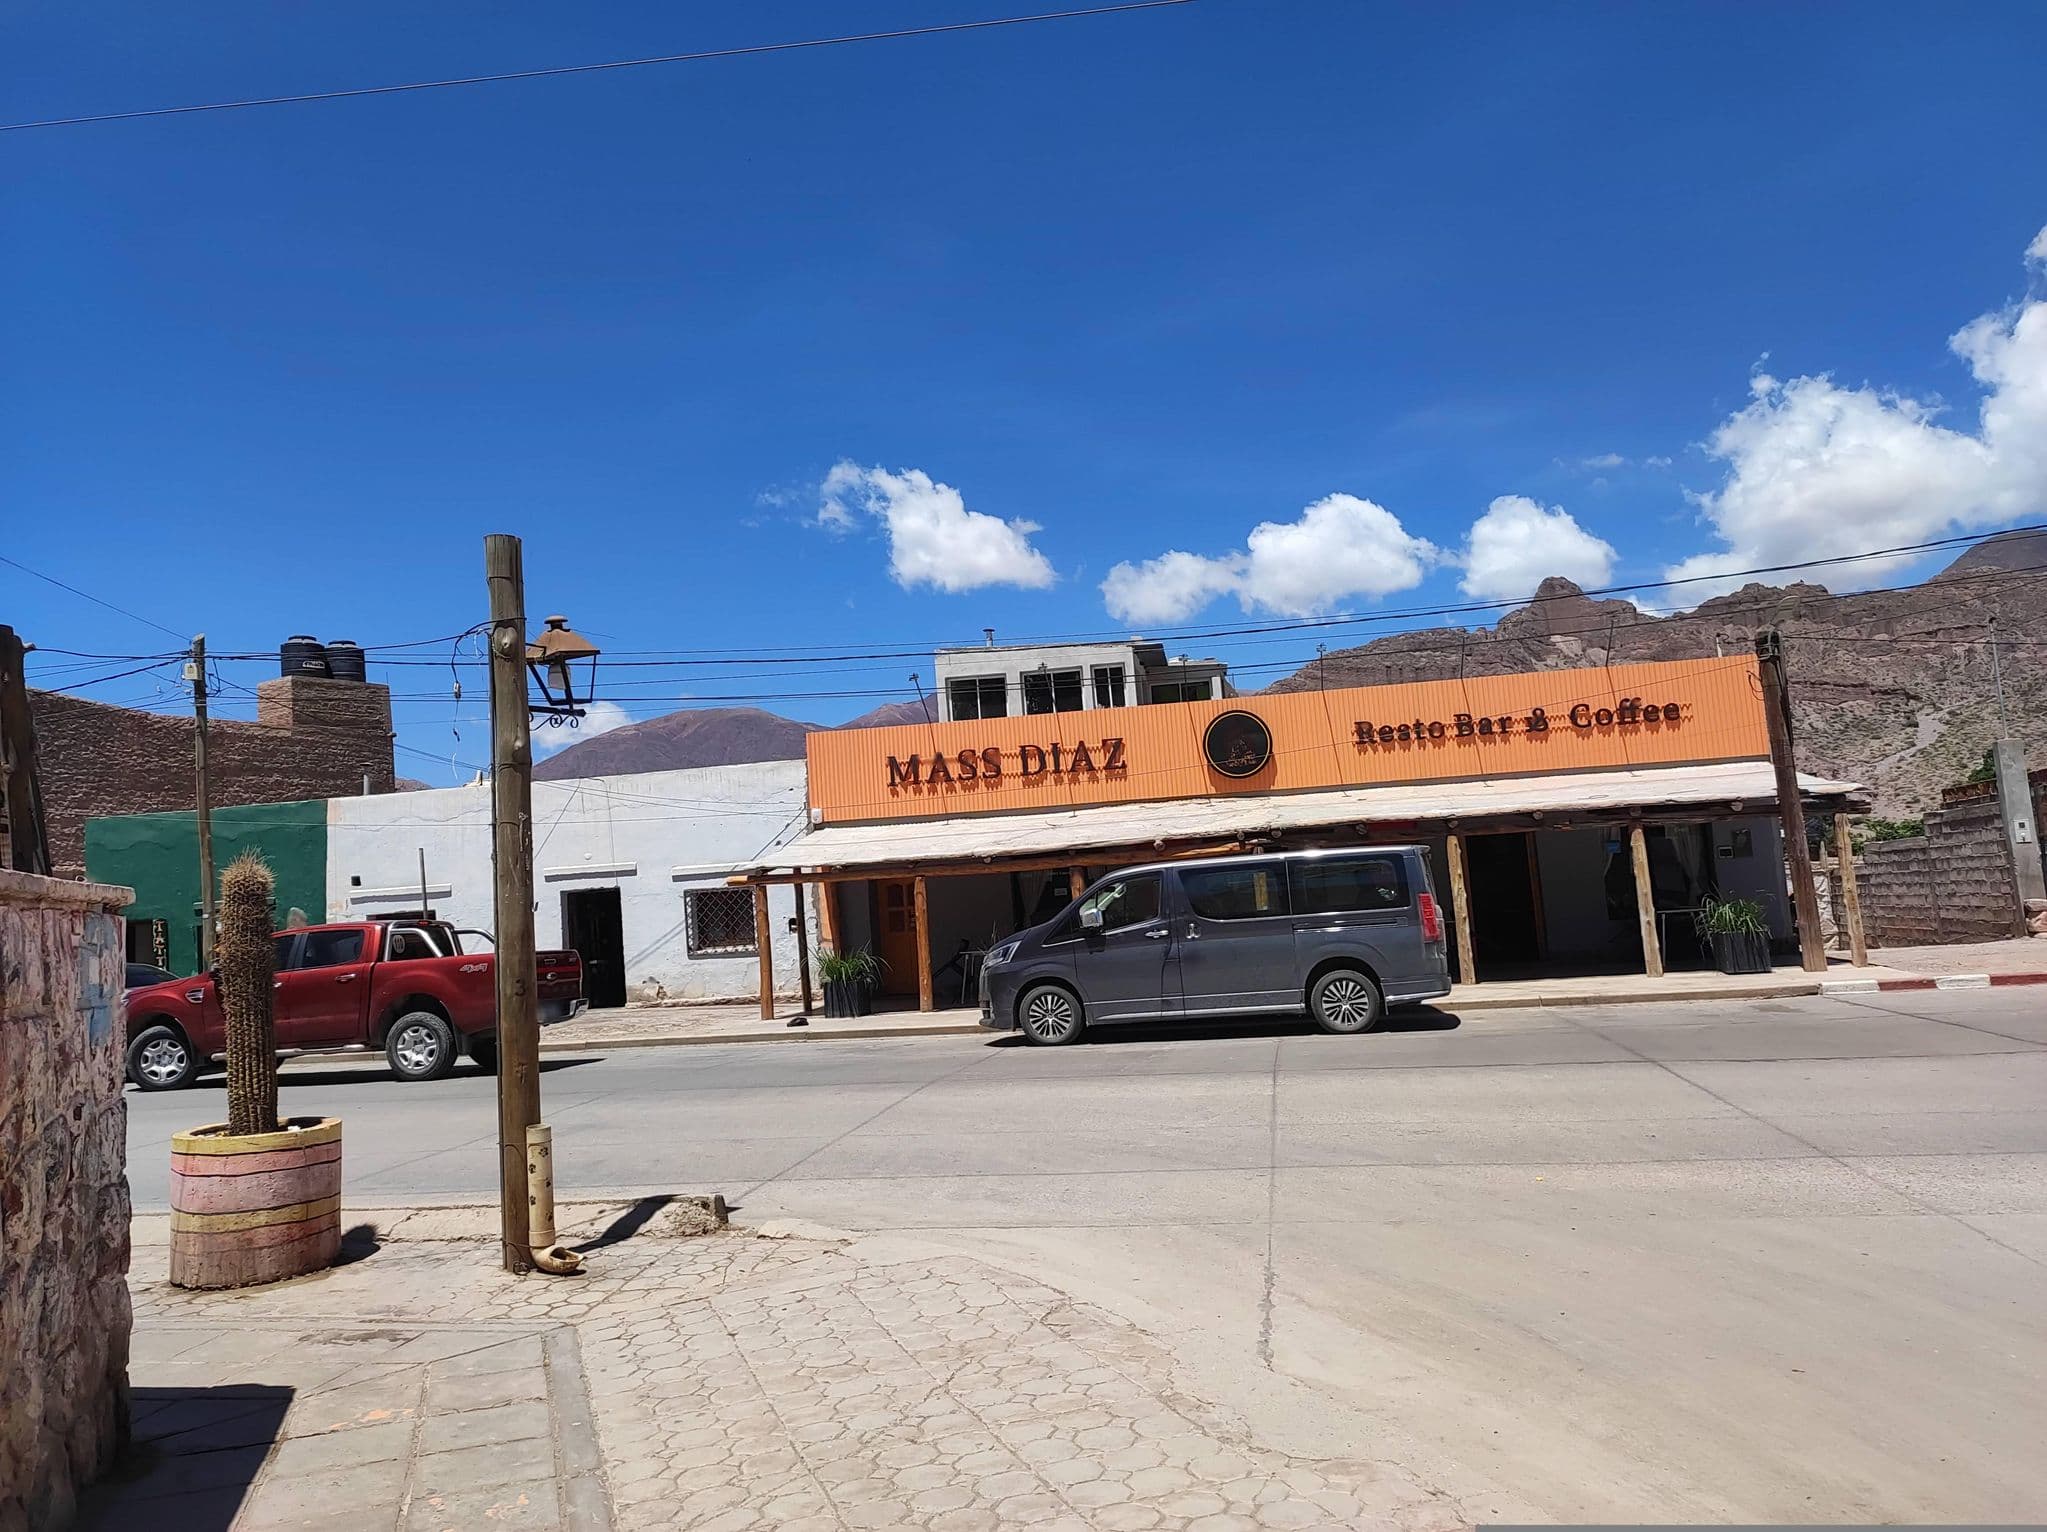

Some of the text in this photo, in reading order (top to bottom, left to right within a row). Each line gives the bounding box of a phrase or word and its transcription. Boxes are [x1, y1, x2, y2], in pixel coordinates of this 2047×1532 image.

[1353, 697, 1682, 745] Resto Bar & Coffee
[887, 738, 1127, 787] MASS DIAZ
